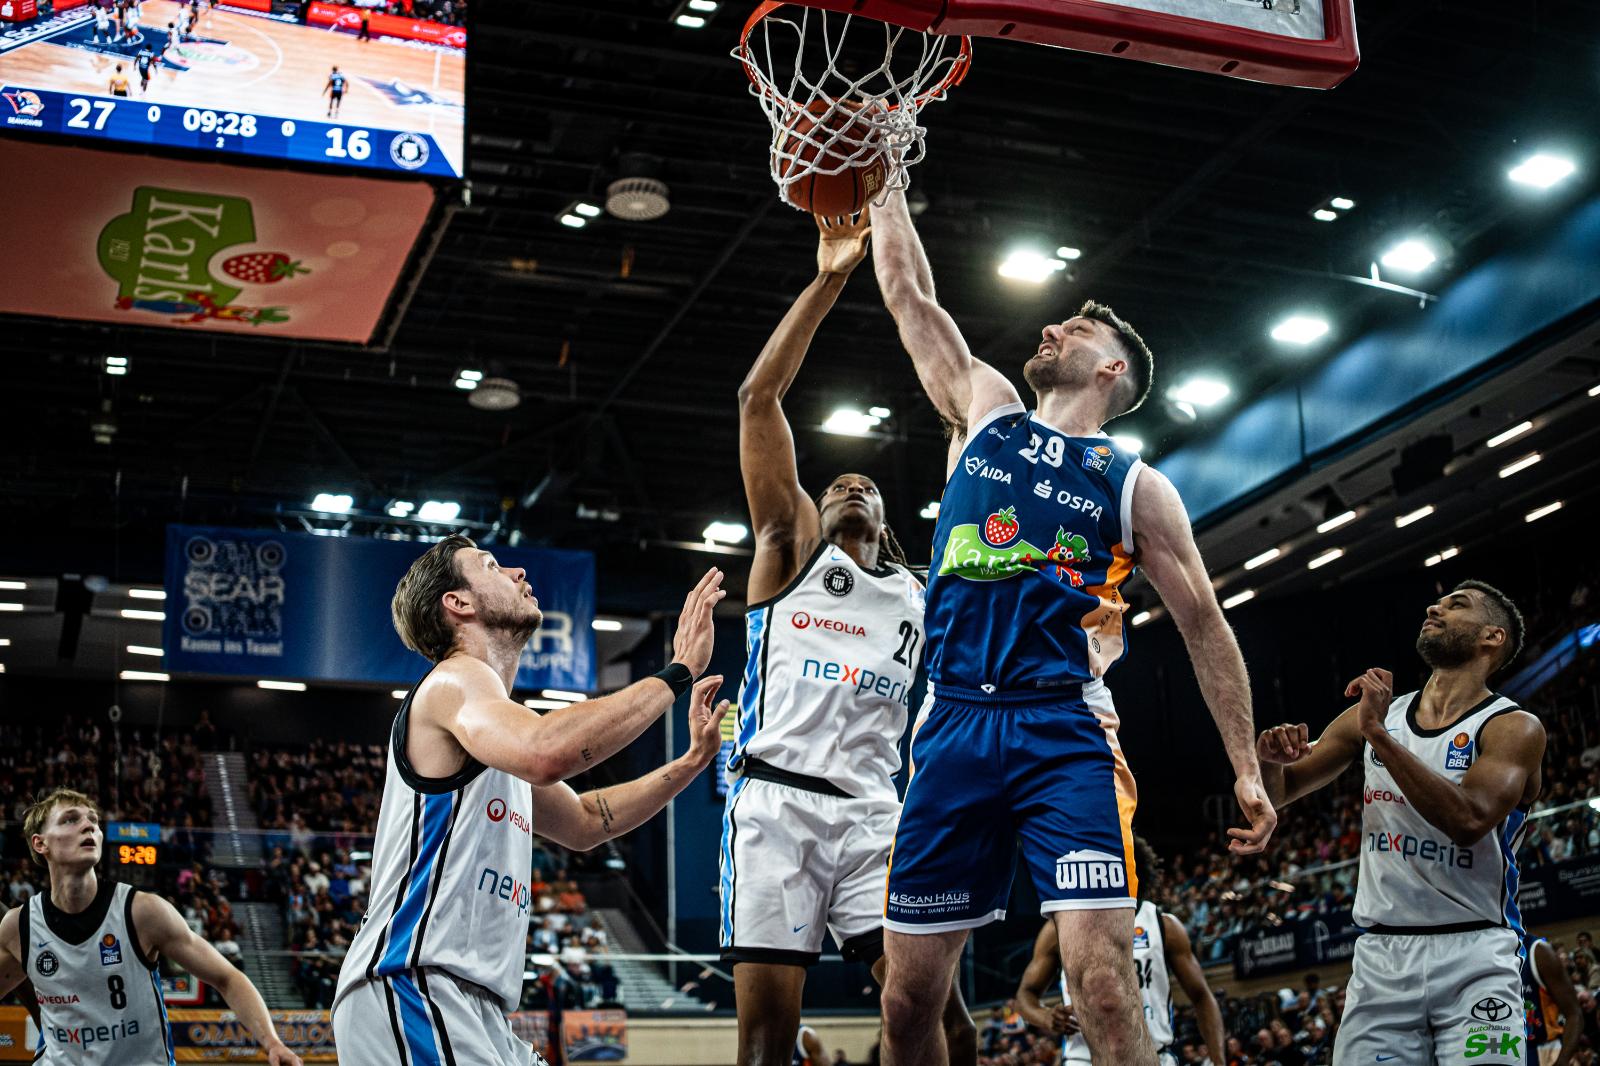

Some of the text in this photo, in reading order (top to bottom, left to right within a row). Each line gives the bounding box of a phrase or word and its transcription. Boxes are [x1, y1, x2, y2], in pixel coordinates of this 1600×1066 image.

[67, 98, 116, 130] 27
[147, 105, 161, 123] 0
[183, 110, 257, 137] 09:28
[216, 137, 224, 147] 2
[281, 121, 296, 137] 0
[325, 128, 371, 160] 16
[134, 196, 223, 302] Karls
[1018, 433, 1065, 468] 29
[979, 466, 1012, 484] AIDA
[1085, 458, 1103, 471] BBL
[1056, 490, 1103, 522] OSPA
[943, 538, 1022, 570] Karl
[184, 571, 285, 604] SEAR
[813, 617, 866, 637] VEOLIA
[1447, 758, 1469, 768] BBL
[509, 809, 530, 835] VEOLIA
[119, 845, 157, 865] 9:28
[1056, 863, 1125, 889] WIRO
[45, 994, 80, 1004] VEOLIA
[108, 974, 127, 1010] 8
[1468, 1024, 1511, 1034] Autohaus
[1464, 1033, 1522, 1059] S+K
